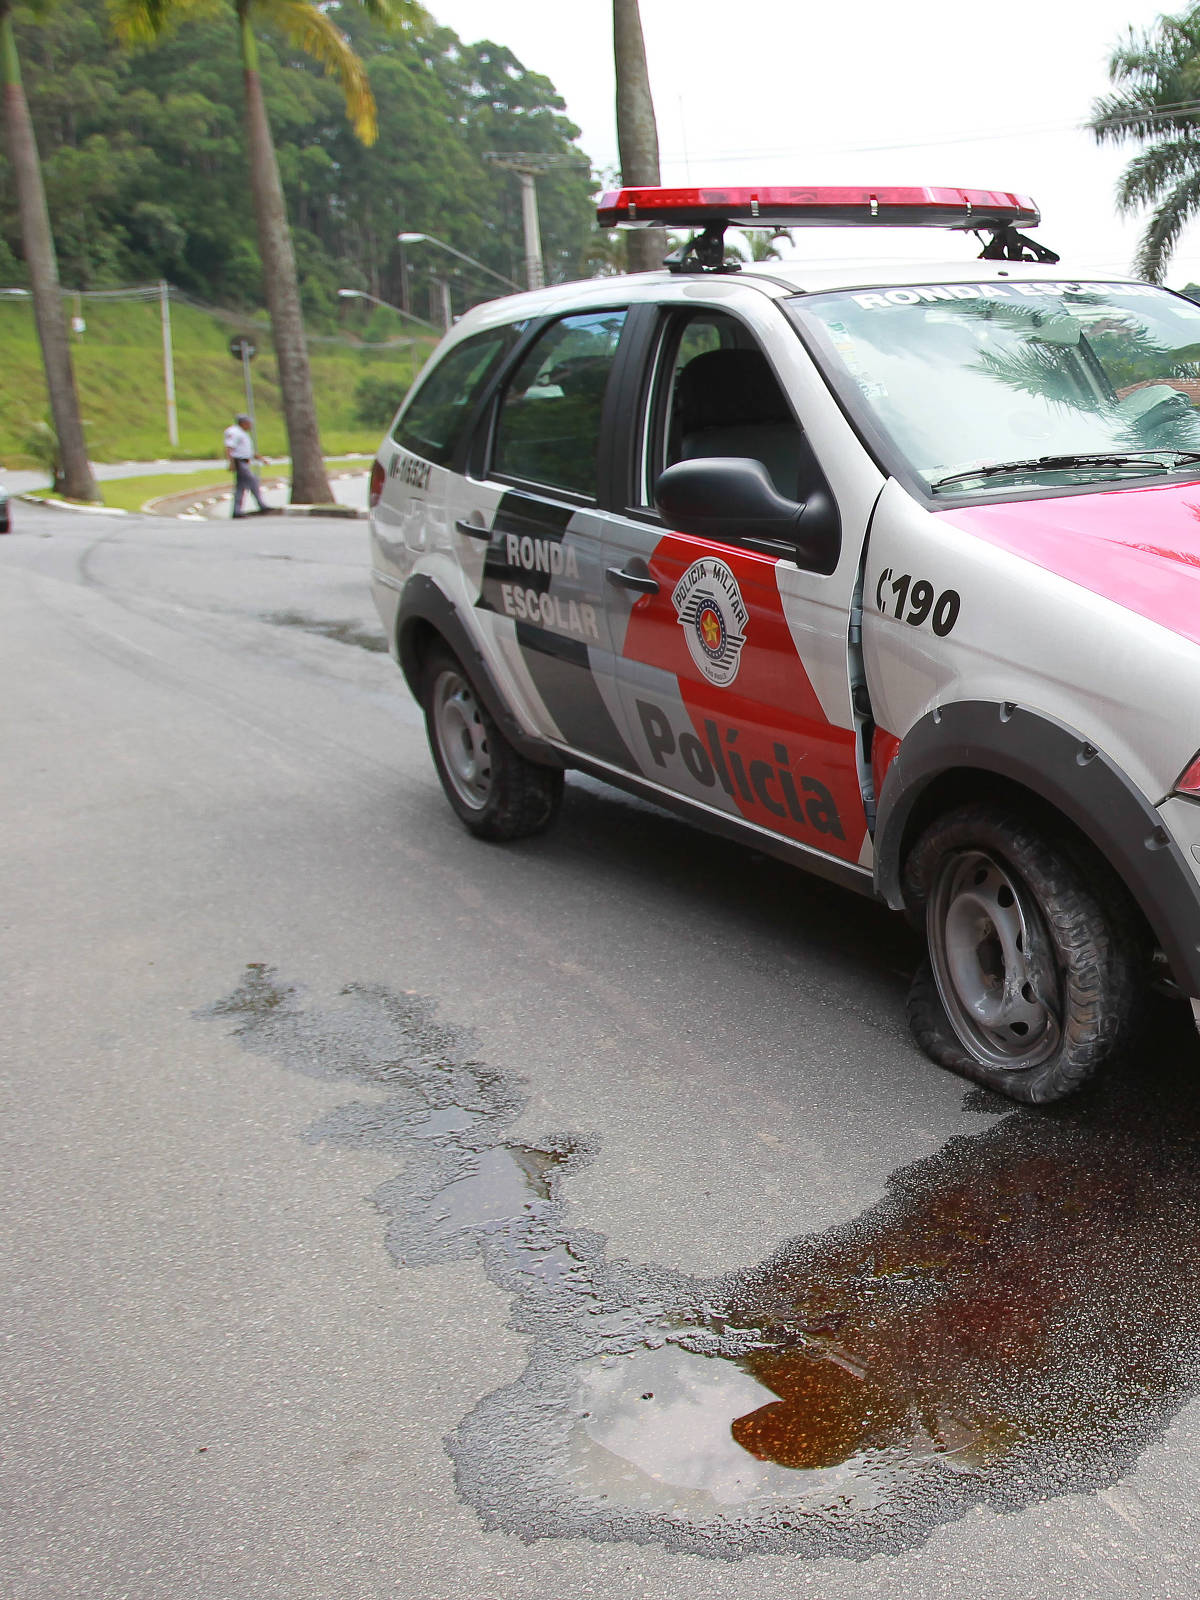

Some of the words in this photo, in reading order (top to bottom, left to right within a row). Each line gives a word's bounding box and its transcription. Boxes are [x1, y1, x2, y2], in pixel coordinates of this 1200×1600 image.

[851, 284, 1009, 310] RONDA
[506, 533, 580, 579] RONDA
[501, 583, 600, 640] ESCOLAR
[712, 563, 745, 624] MILITAR
[891, 574, 961, 637] 190
[636, 699, 847, 841] Polícia
